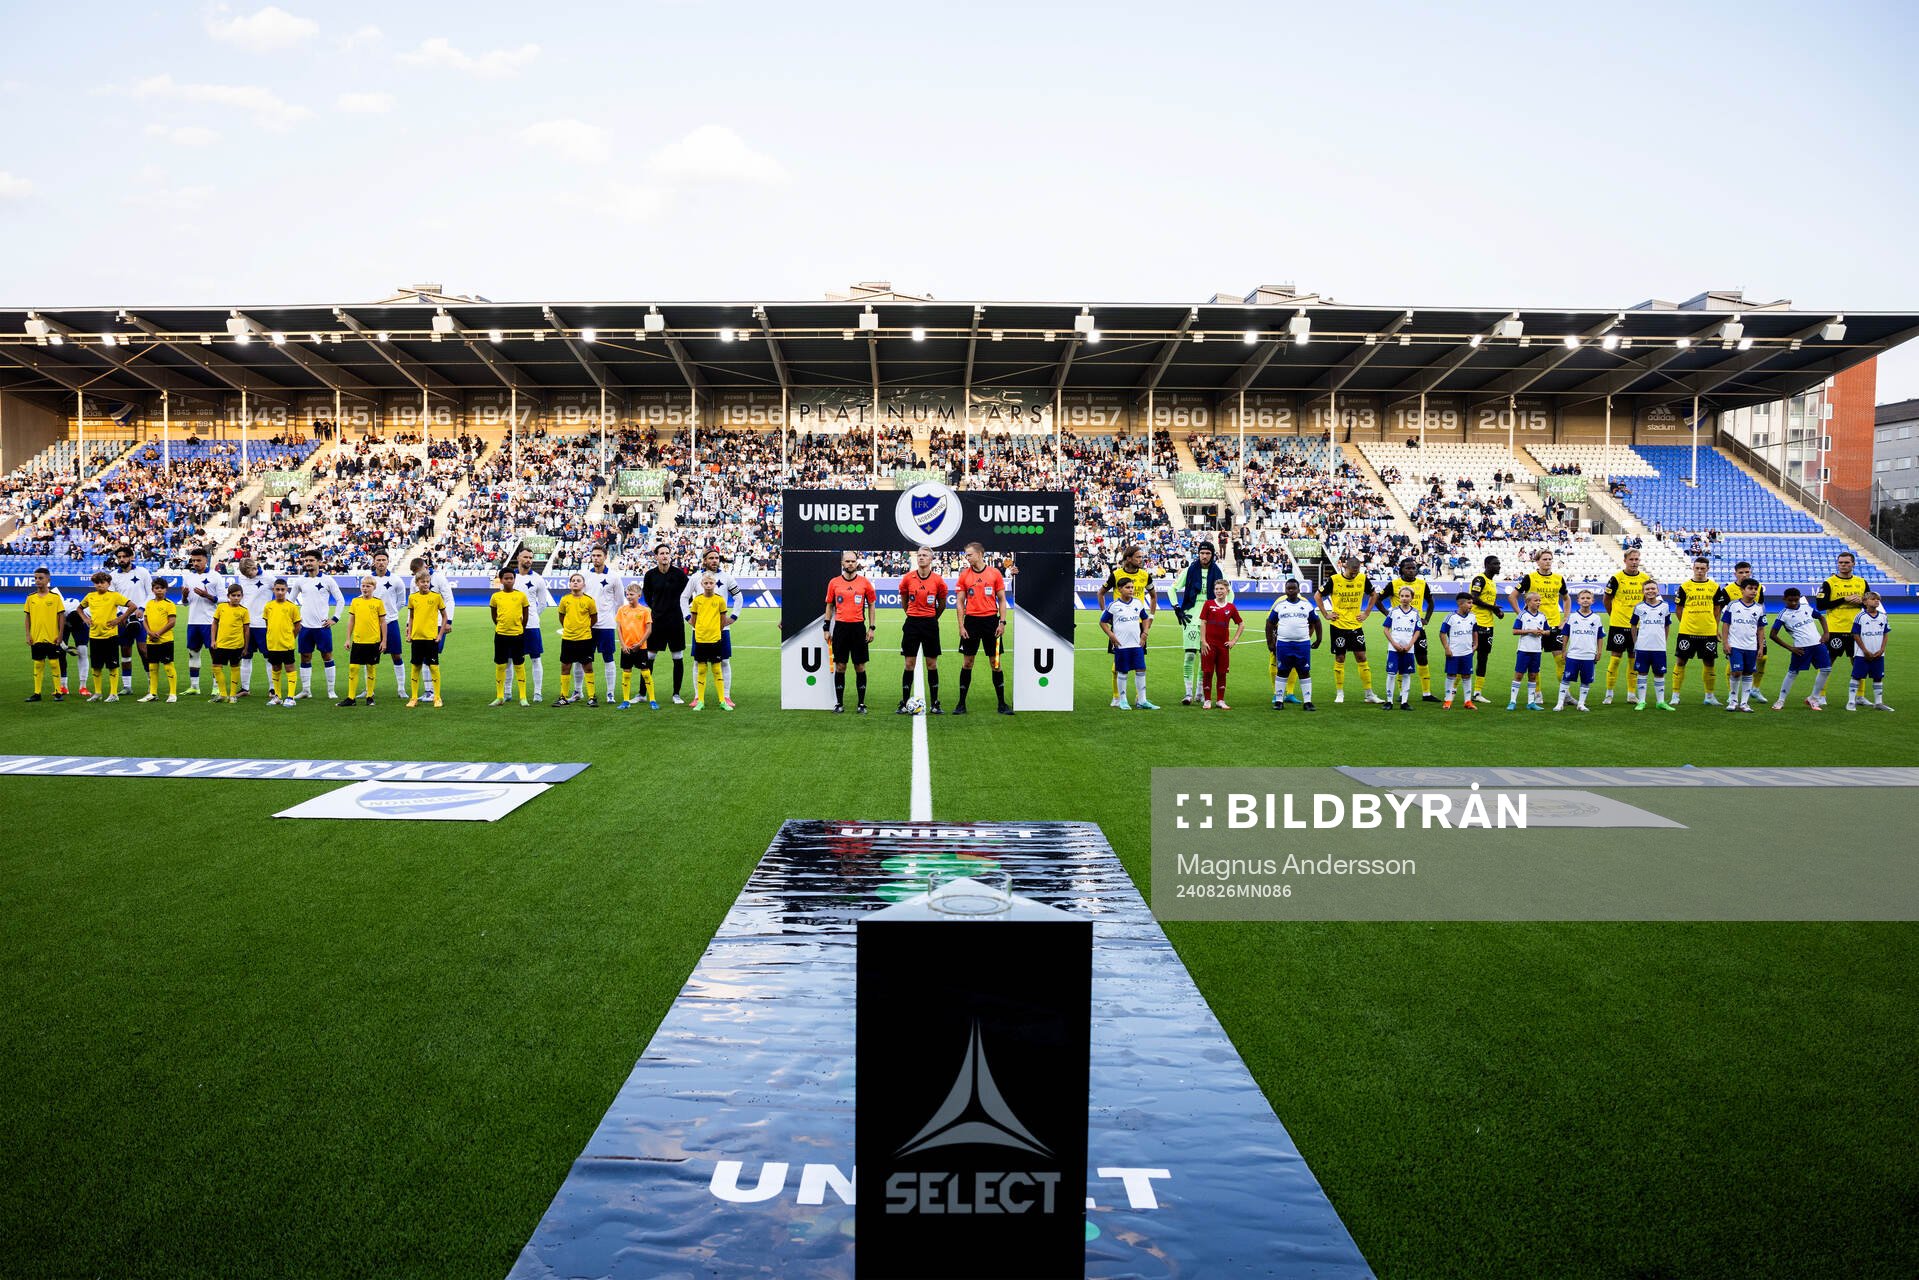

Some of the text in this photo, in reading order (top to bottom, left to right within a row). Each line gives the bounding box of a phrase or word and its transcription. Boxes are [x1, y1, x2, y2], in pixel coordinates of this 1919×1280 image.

[226, 406, 287, 426] 1943
[303, 406, 369, 426] 1945
[389, 406, 452, 426] 1946
[471, 405, 532, 425] 1947
[553, 405, 617, 425] 1948
[636, 405, 700, 425] 1952
[720, 405, 783, 425] 1956
[800, 403, 955, 423] PLATNUM
[1060, 406, 1122, 426] 1957
[1143, 406, 1208, 427] 1960
[1228, 407, 1292, 428] 1962
[1312, 408, 1375, 428] 1963
[1395, 409, 1458, 430] 1989
[1479, 409, 1547, 430] 2015
[1647, 413, 1676, 421] adidas
[1647, 423, 1676, 431] stadium
[799, 504, 879, 521] UNIBET
[979, 505, 1059, 522] UNIBET
[801, 647, 822, 673] U
[1034, 648, 1054, 674] U
[0, 757, 558, 782] ALLSVENSKAN
[840, 828, 1041, 839] UNIBET
[708, 1160, 1171, 1209] UNT
[885, 1171, 1061, 1215] SELECT
